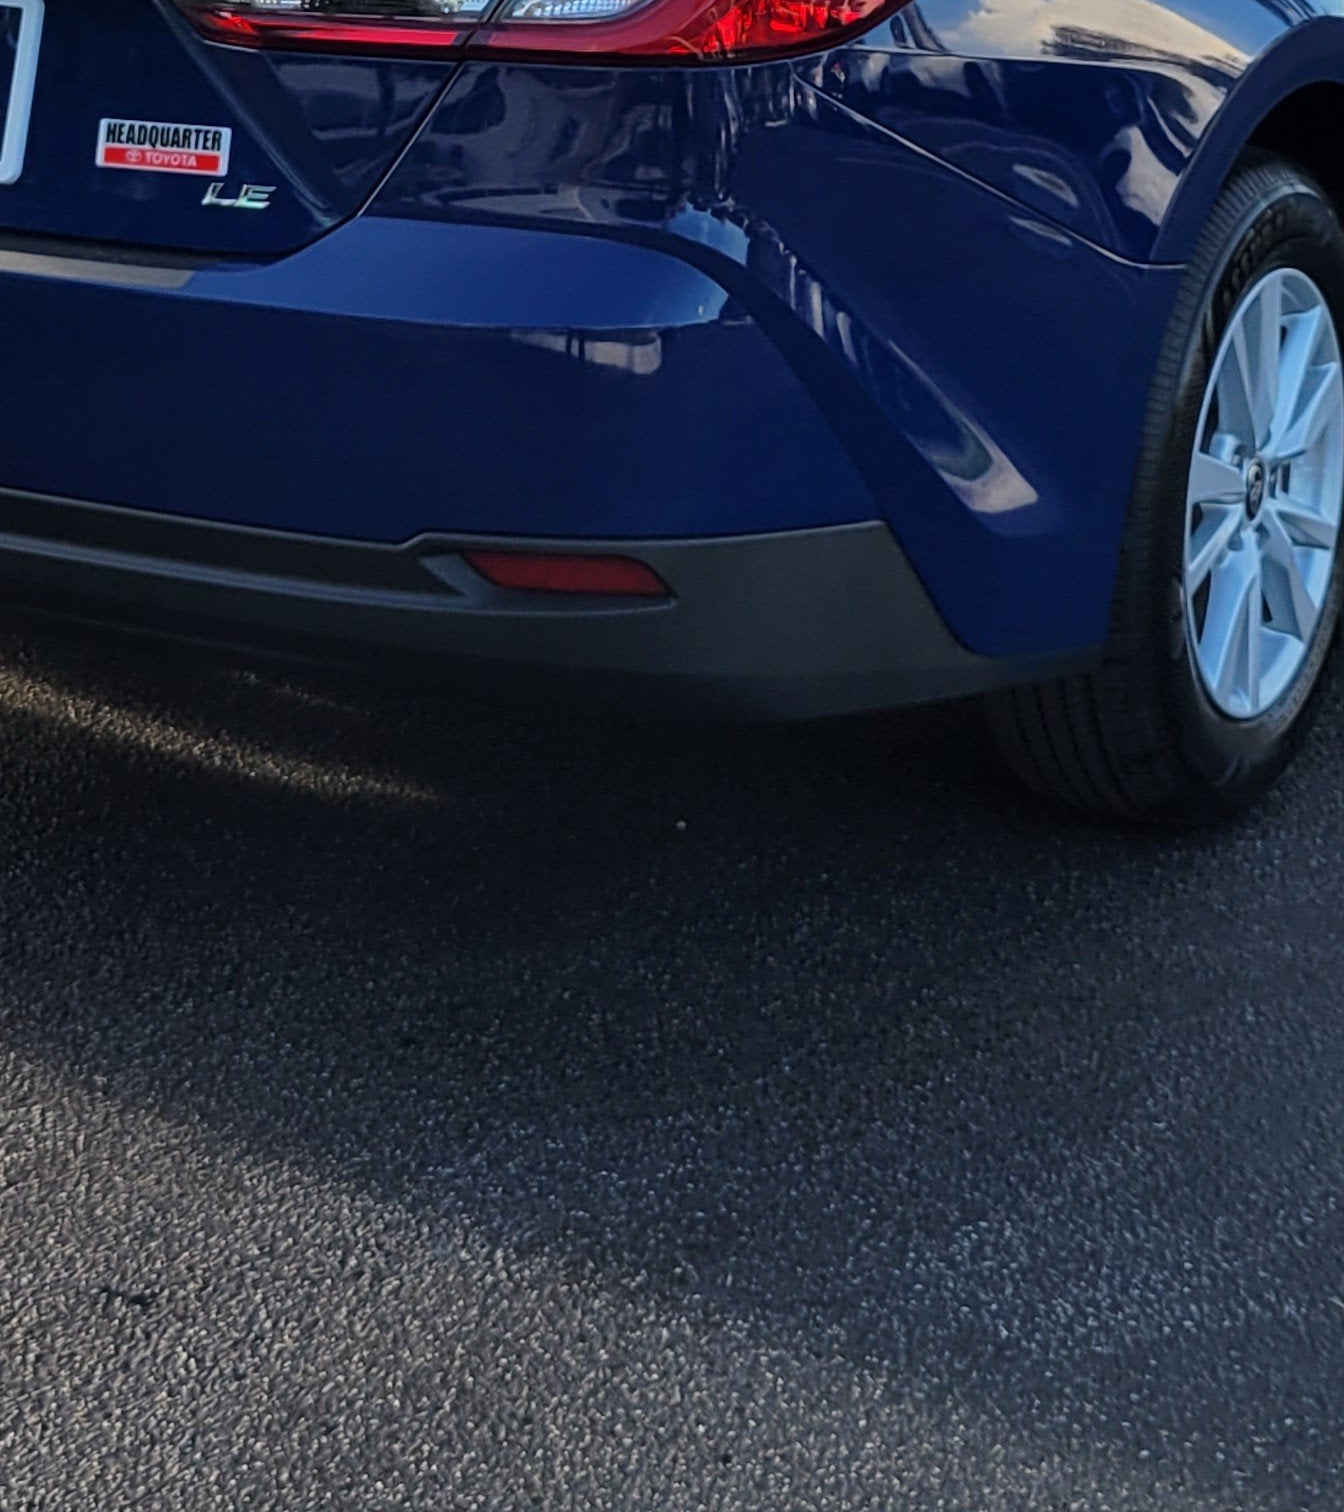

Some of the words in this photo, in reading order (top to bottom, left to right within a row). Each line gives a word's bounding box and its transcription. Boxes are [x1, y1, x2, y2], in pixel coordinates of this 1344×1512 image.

[105, 122, 223, 152] HEADQUARTER
[145, 150, 198, 168] TOYOTA
[201, 182, 278, 210] LE
